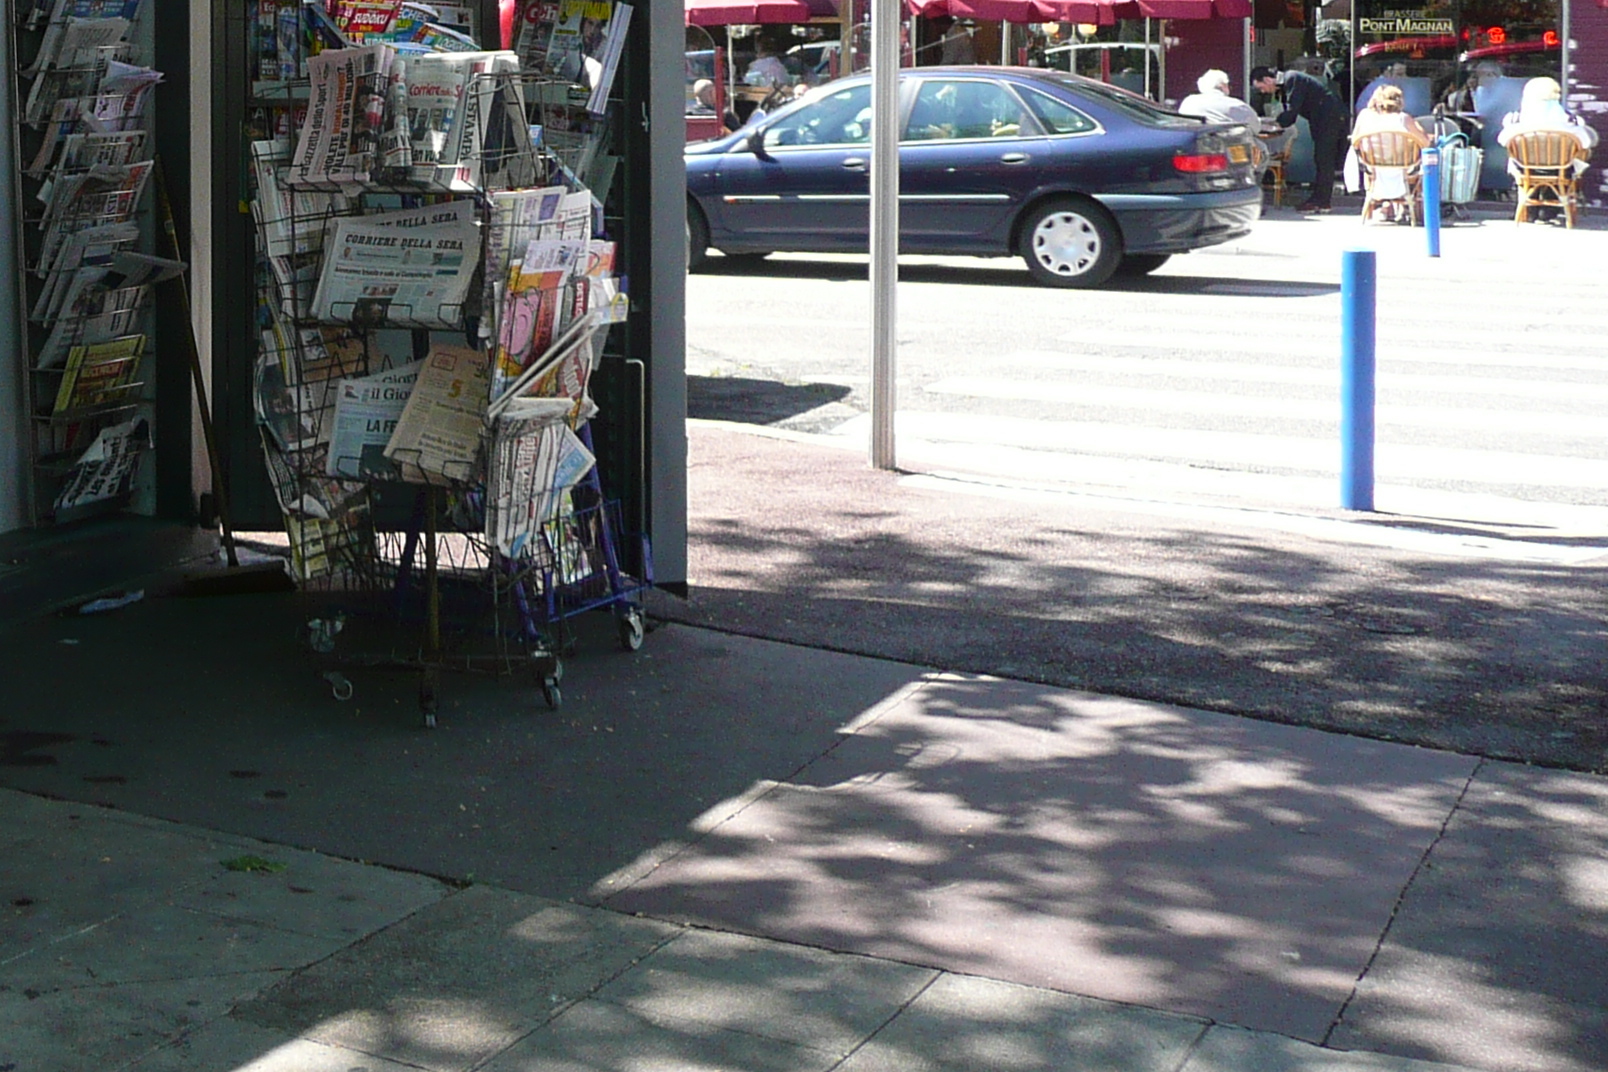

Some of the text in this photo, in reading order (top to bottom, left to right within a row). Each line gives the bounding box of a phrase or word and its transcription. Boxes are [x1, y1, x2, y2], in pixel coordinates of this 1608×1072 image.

[345, 234, 464, 251] CORRIERE DELLA SERA
